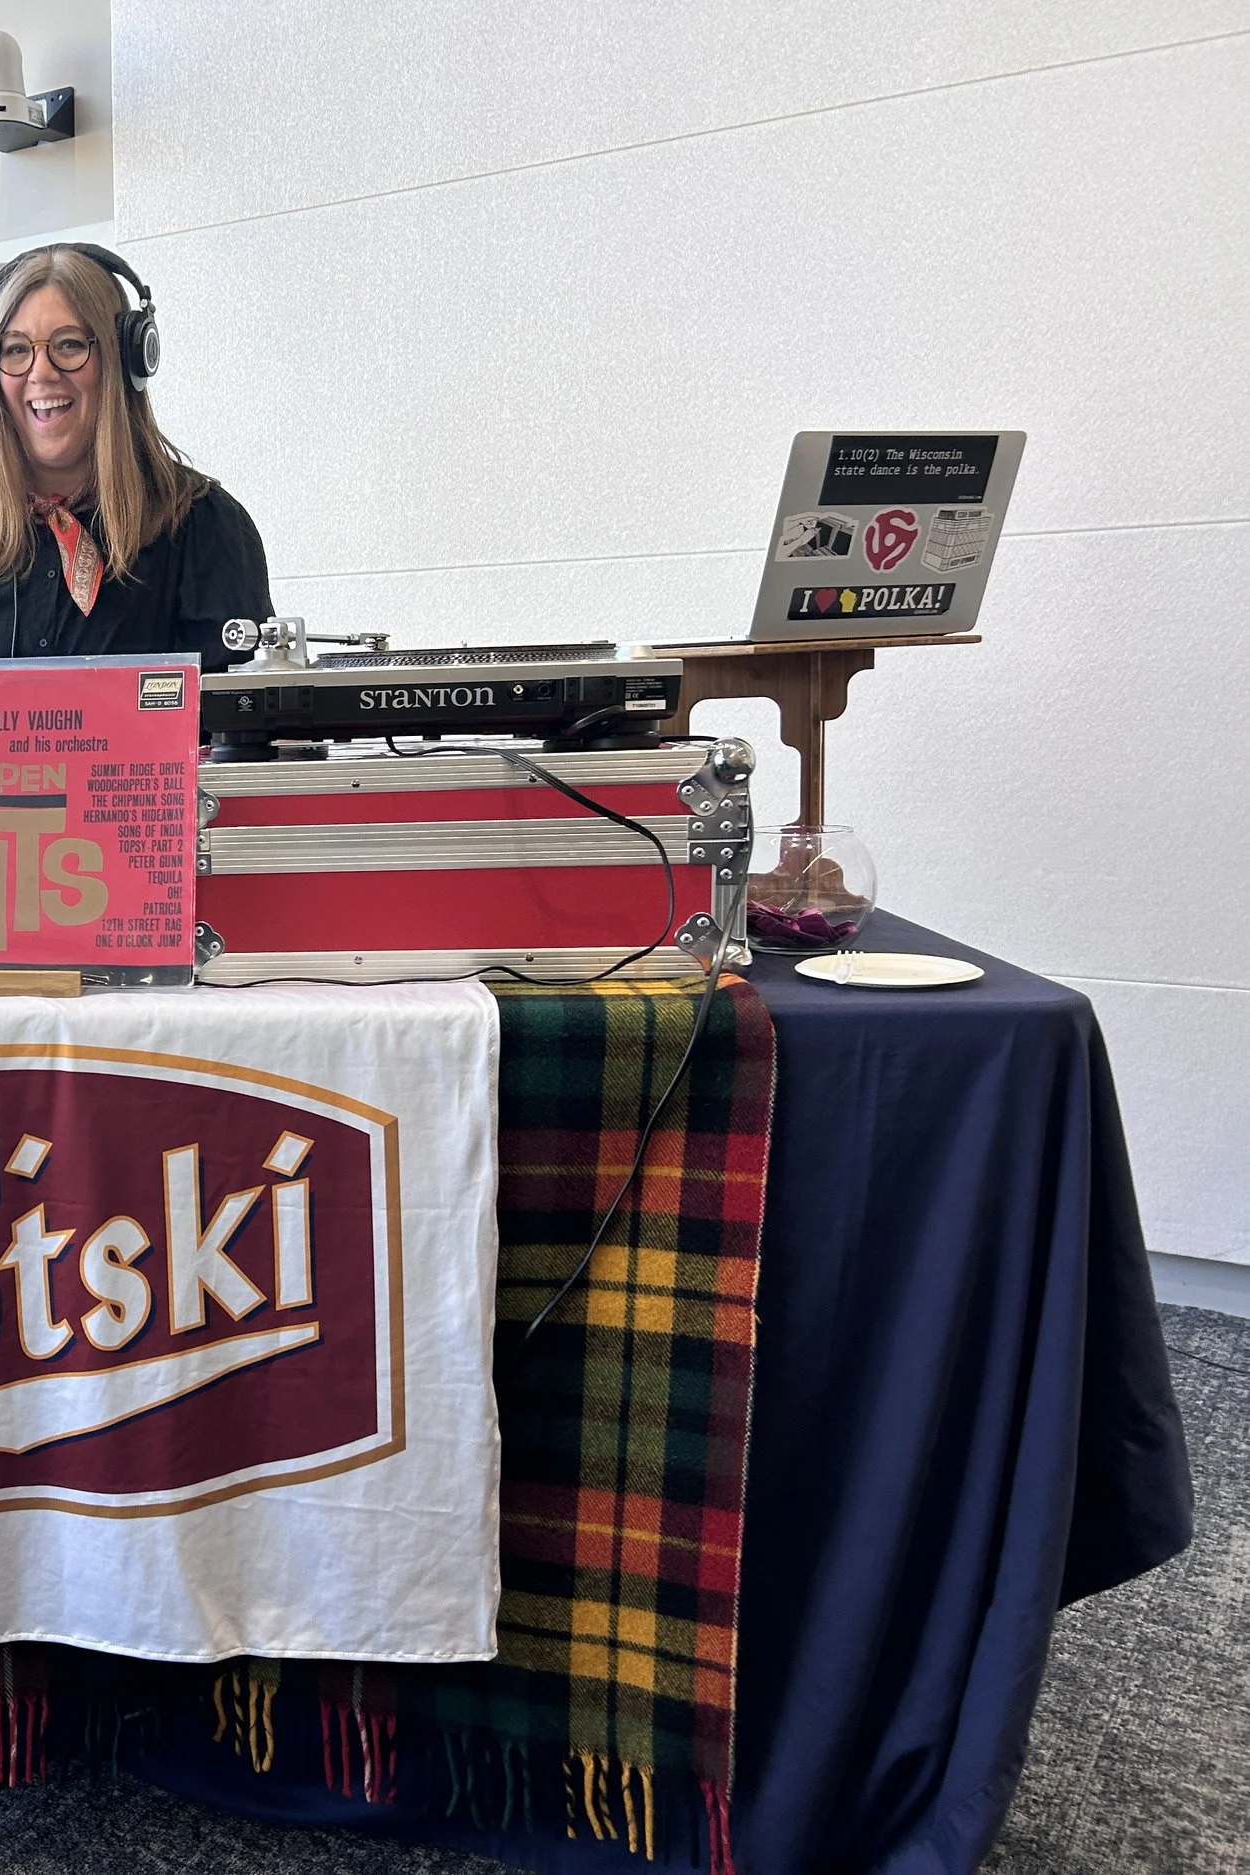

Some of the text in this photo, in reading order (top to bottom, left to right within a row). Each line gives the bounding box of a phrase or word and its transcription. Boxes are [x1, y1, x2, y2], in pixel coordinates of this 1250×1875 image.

[838, 449, 963, 462] 1.10(2) The Wisconsin
[834, 464, 980, 477] state dance is the polka.
[800, 586, 945, 613] I POLKA!
[146, 681, 180, 691] LONDON
[28, 709, 83, 730] VAUGHN
[10, 735, 108, 752] and his orchestra
[91, 762, 185, 777] SUMMIT RIDGE DRIVE
[87, 777, 184, 792] WOODCHOPPER'S BALL
[92, 793, 184, 807] THE CHIPMUNK SONG
[83, 808, 184, 823] HERNANDO'S HIDEAWAY
[118, 824, 183, 838] SONG OF INDIA
[177, 839, 183, 852] 2
[128, 854, 183, 868] PETER GUNN
[147, 871, 182, 885] TEQUILA
[167, 886, 182, 899] OH!
[143, 902, 182, 915] PATRICIA
[102, 918, 182, 931] 12TH STREET RAG
[95, 934, 182, 947] ONE O'CLOCK JUMP
